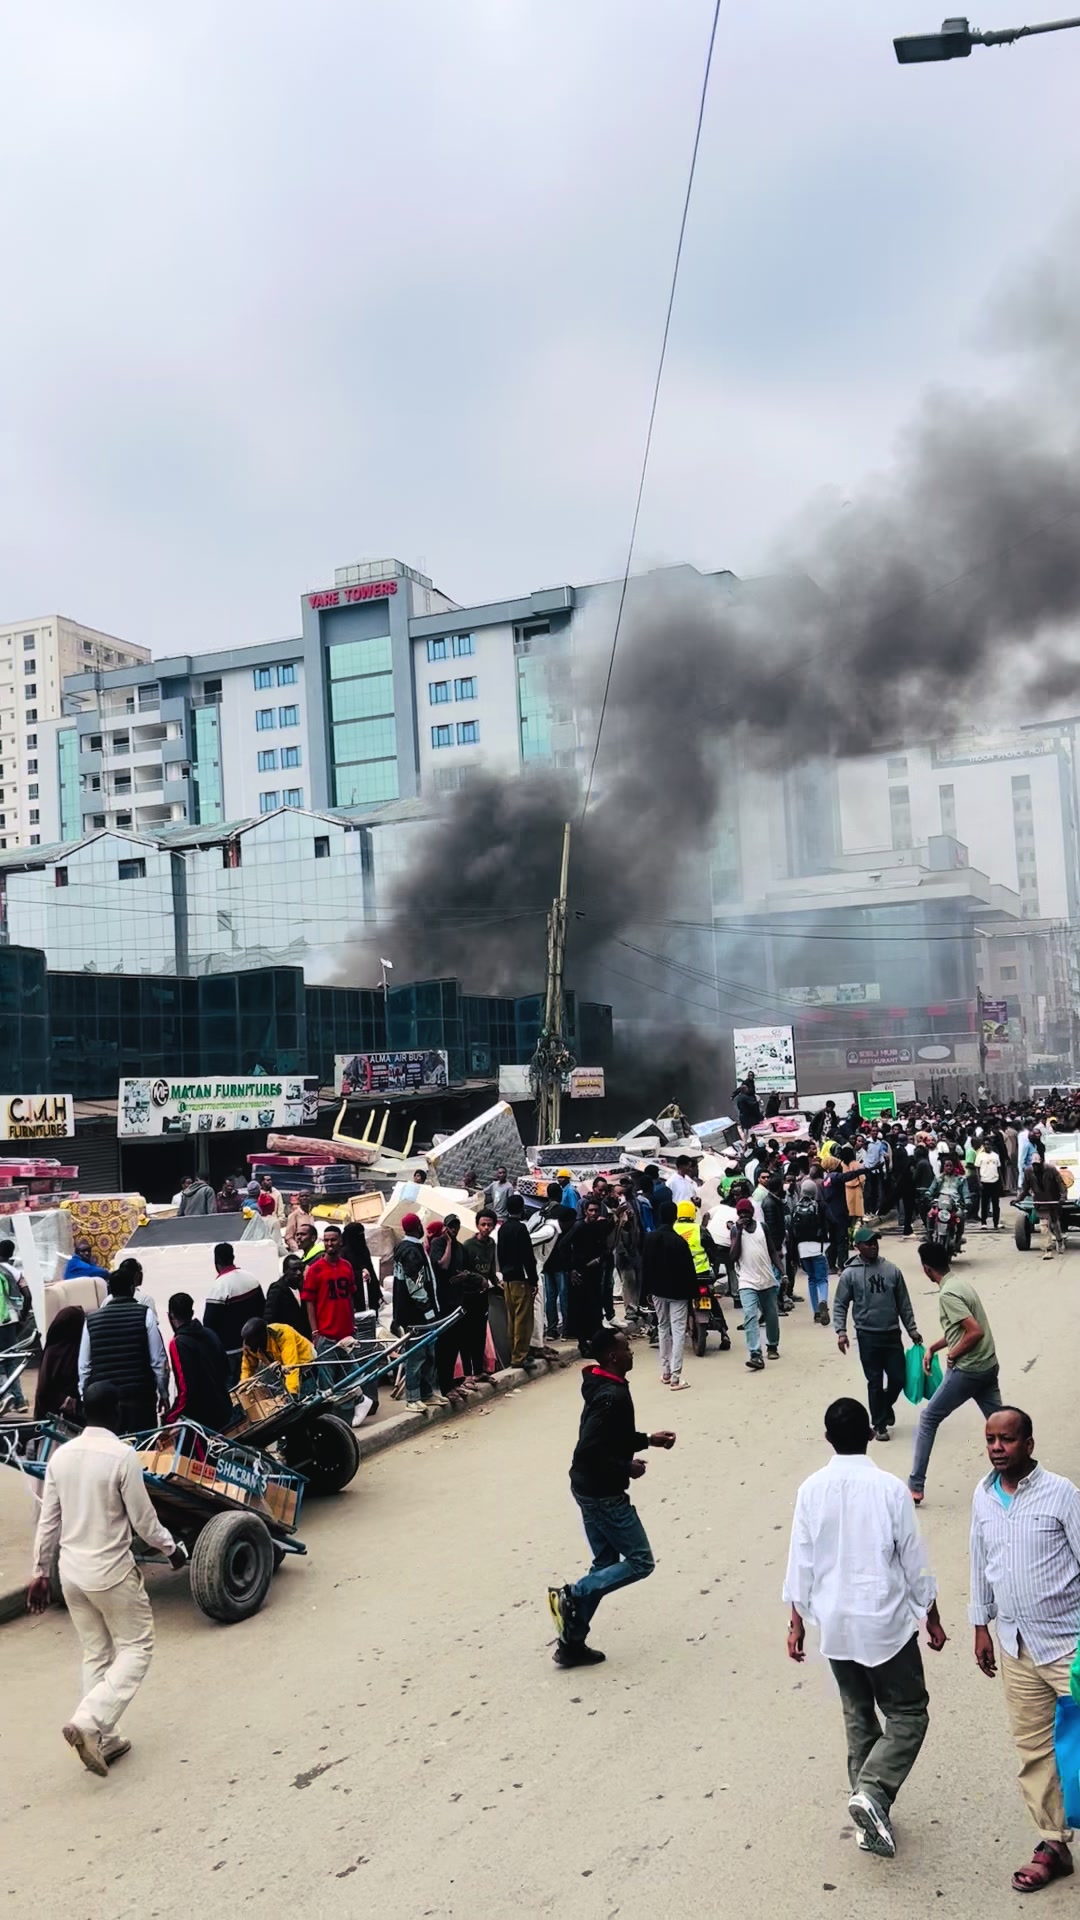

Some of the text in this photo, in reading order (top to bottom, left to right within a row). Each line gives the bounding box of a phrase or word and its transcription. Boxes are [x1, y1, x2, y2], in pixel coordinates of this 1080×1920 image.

[308, 581, 398, 609] YARE TOWERS
[370, 1051, 424, 1064] ALMA AIR BUS
[170, 1083, 282, 1099] MATAN FURNITURES
[8, 1123, 68, 1138] FURNITURES
[327, 1277, 350, 1300] 19
